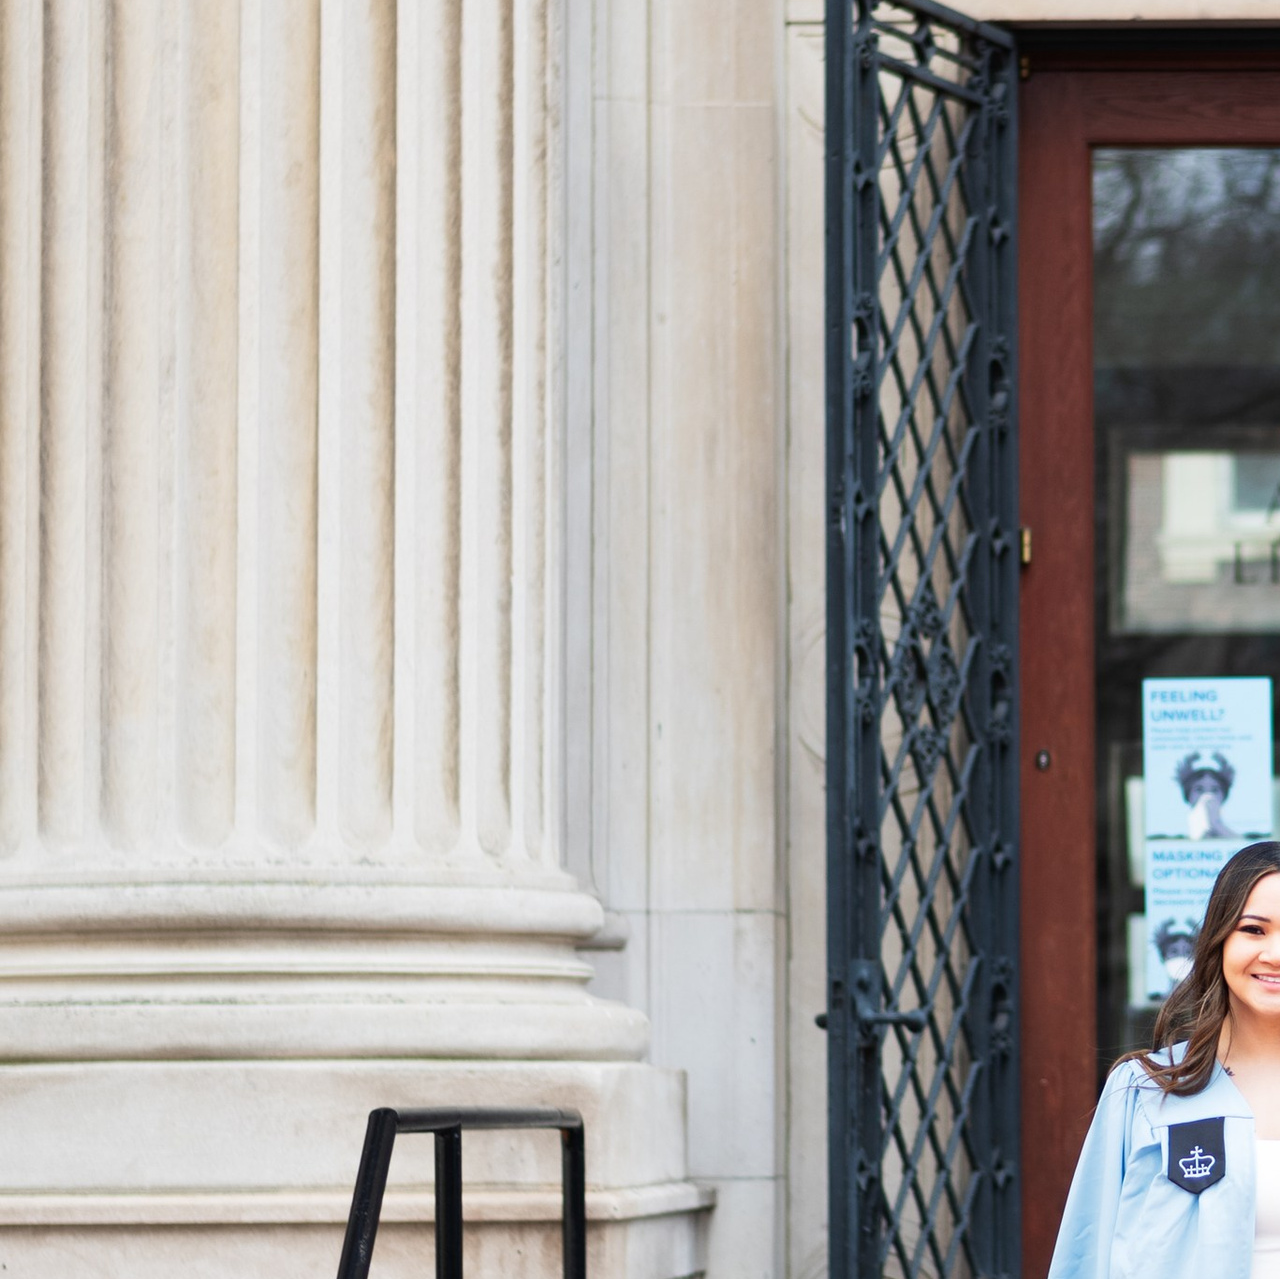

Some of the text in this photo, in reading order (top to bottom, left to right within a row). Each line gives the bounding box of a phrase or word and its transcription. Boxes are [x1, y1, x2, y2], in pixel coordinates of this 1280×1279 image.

[1150, 690, 1218, 703] FEELING
[1150, 708, 1226, 722] UNWELL?
[1152, 851, 1223, 862] MASKING
[1152, 868, 1220, 880] OPTIONA
